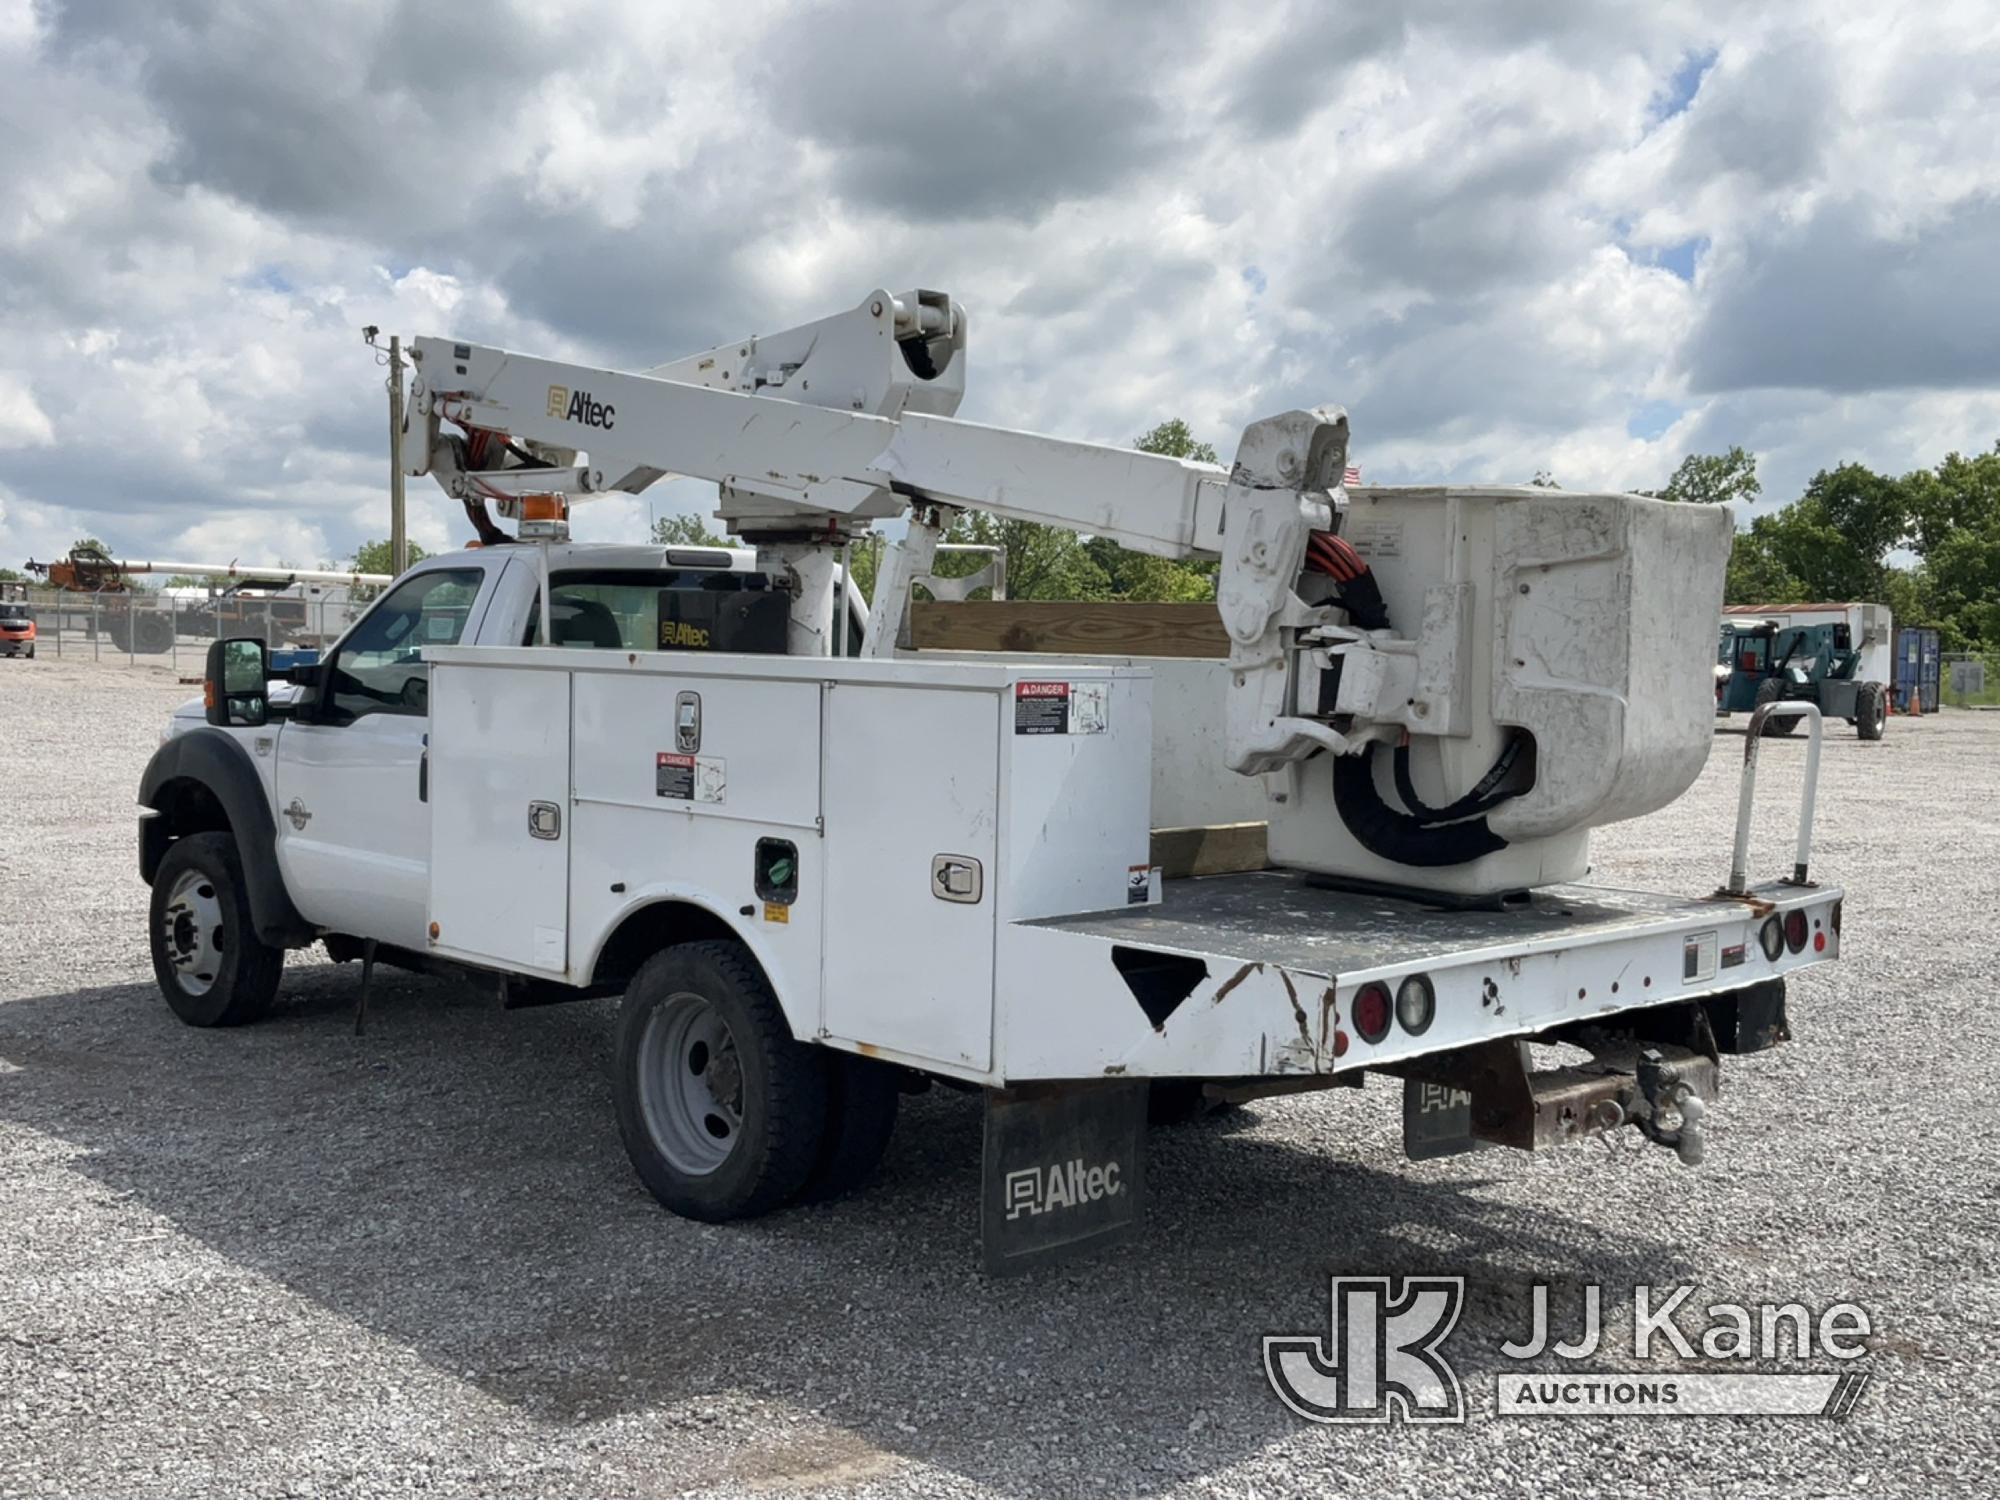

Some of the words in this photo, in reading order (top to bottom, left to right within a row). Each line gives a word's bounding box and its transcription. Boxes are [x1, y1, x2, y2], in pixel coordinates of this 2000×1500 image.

[566, 390, 616, 430] Altec
[675, 623, 709, 646] Altec
[1030, 684, 1064, 695] DANGER
[1045, 1159, 1120, 1211] Altec
